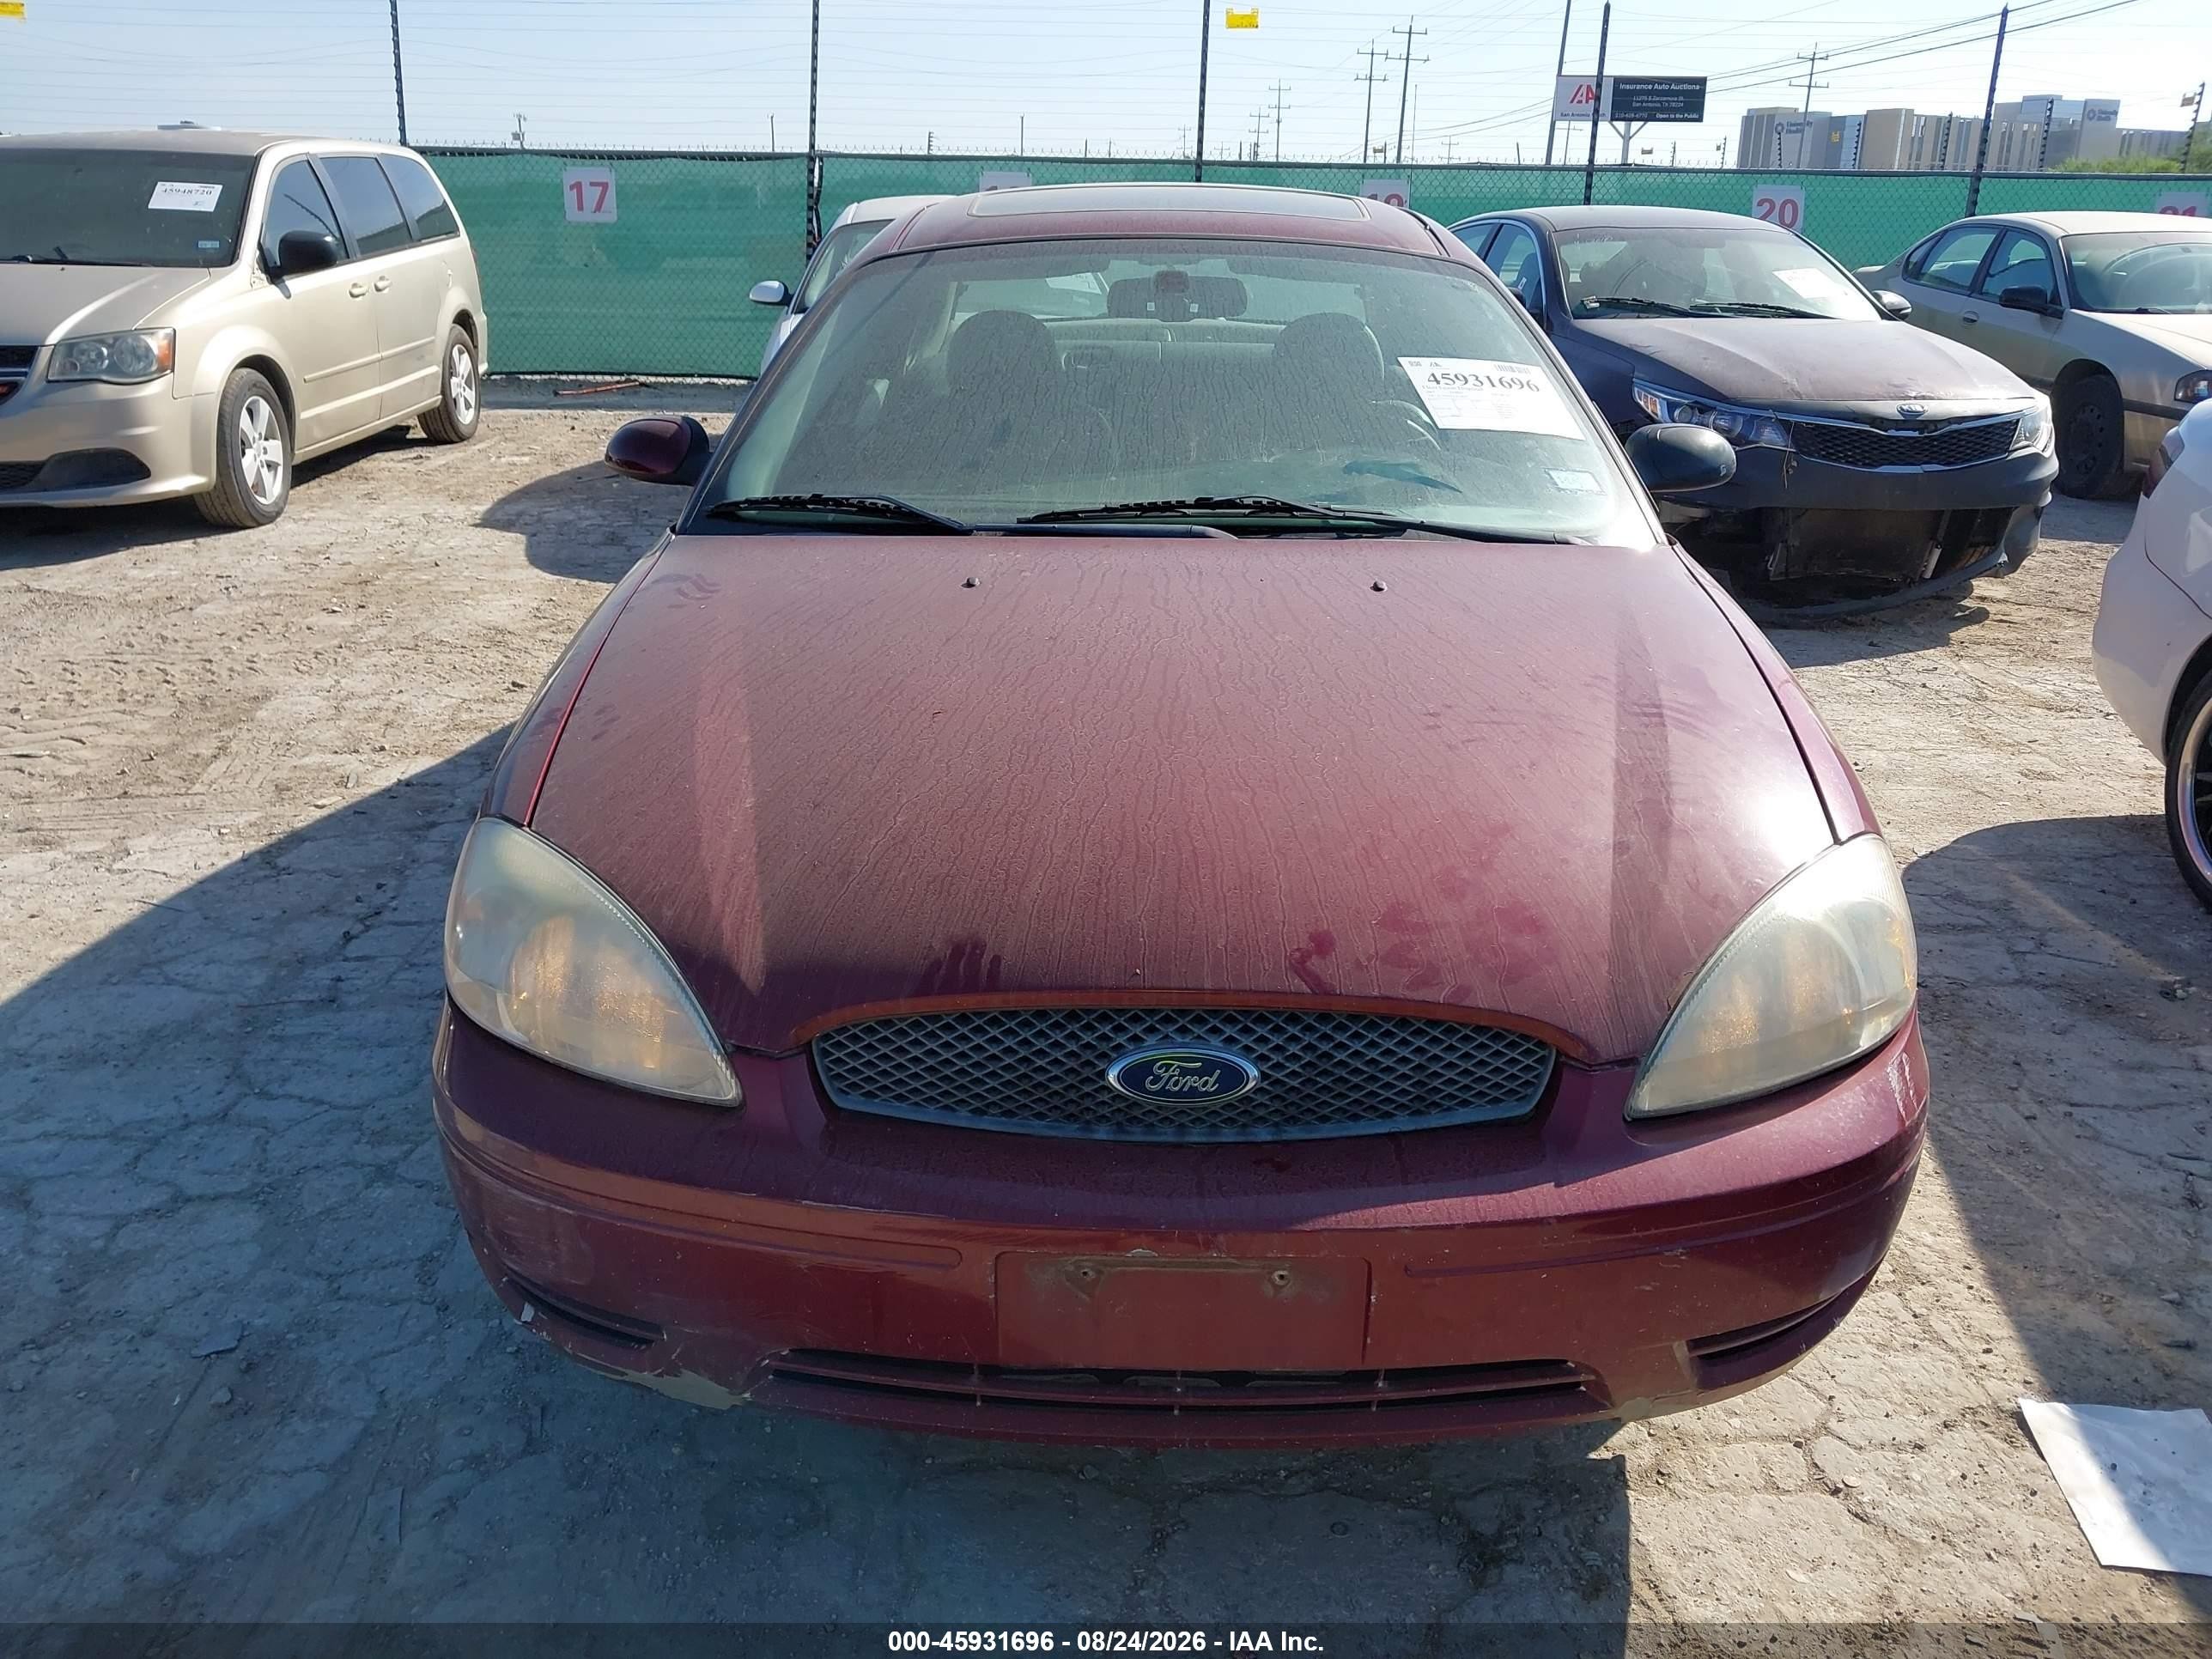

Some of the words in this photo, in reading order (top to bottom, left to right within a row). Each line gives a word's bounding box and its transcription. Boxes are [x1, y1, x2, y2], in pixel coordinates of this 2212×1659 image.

[568, 180, 610, 213] 17
[1756, 198, 1799, 229] 20
[1427, 372, 1540, 392] 45931696
[1145, 1060, 1221, 1092] Ford
